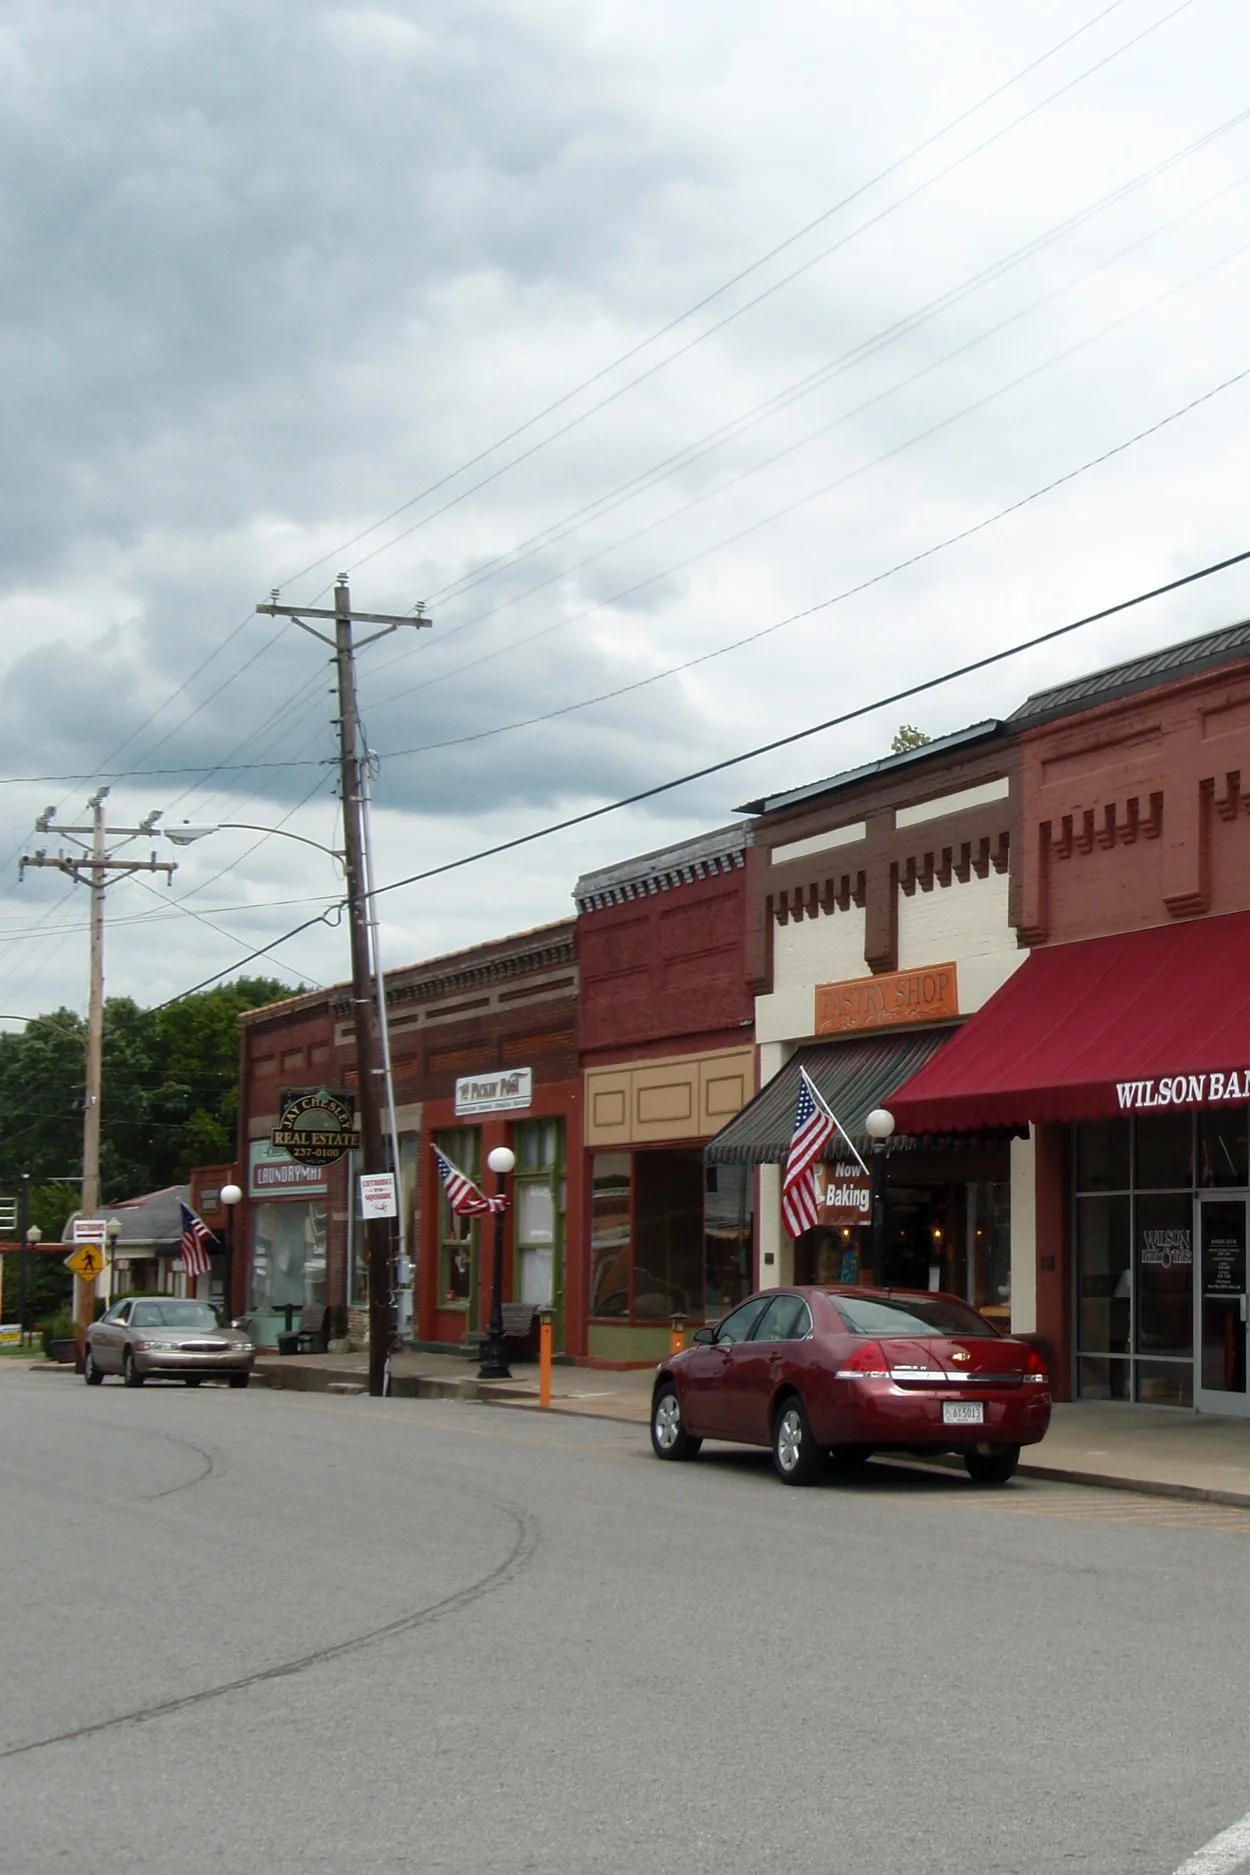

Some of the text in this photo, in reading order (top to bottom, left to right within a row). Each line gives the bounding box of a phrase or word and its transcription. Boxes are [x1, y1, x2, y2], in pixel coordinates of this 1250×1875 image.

[822, 973, 949, 1019] PASTRY SHOP
[1116, 1075, 1206, 1109] WILSON
[283, 1097, 351, 1129] JAY CHESLEY
[274, 1131, 358, 1146] REAL ESTATE
[294, 1148, 339, 1157] 237-0100
[836, 1162, 861, 1177] Now
[826, 1184, 870, 1212] Baking
[1143, 1230, 1191, 1250] WILSON
